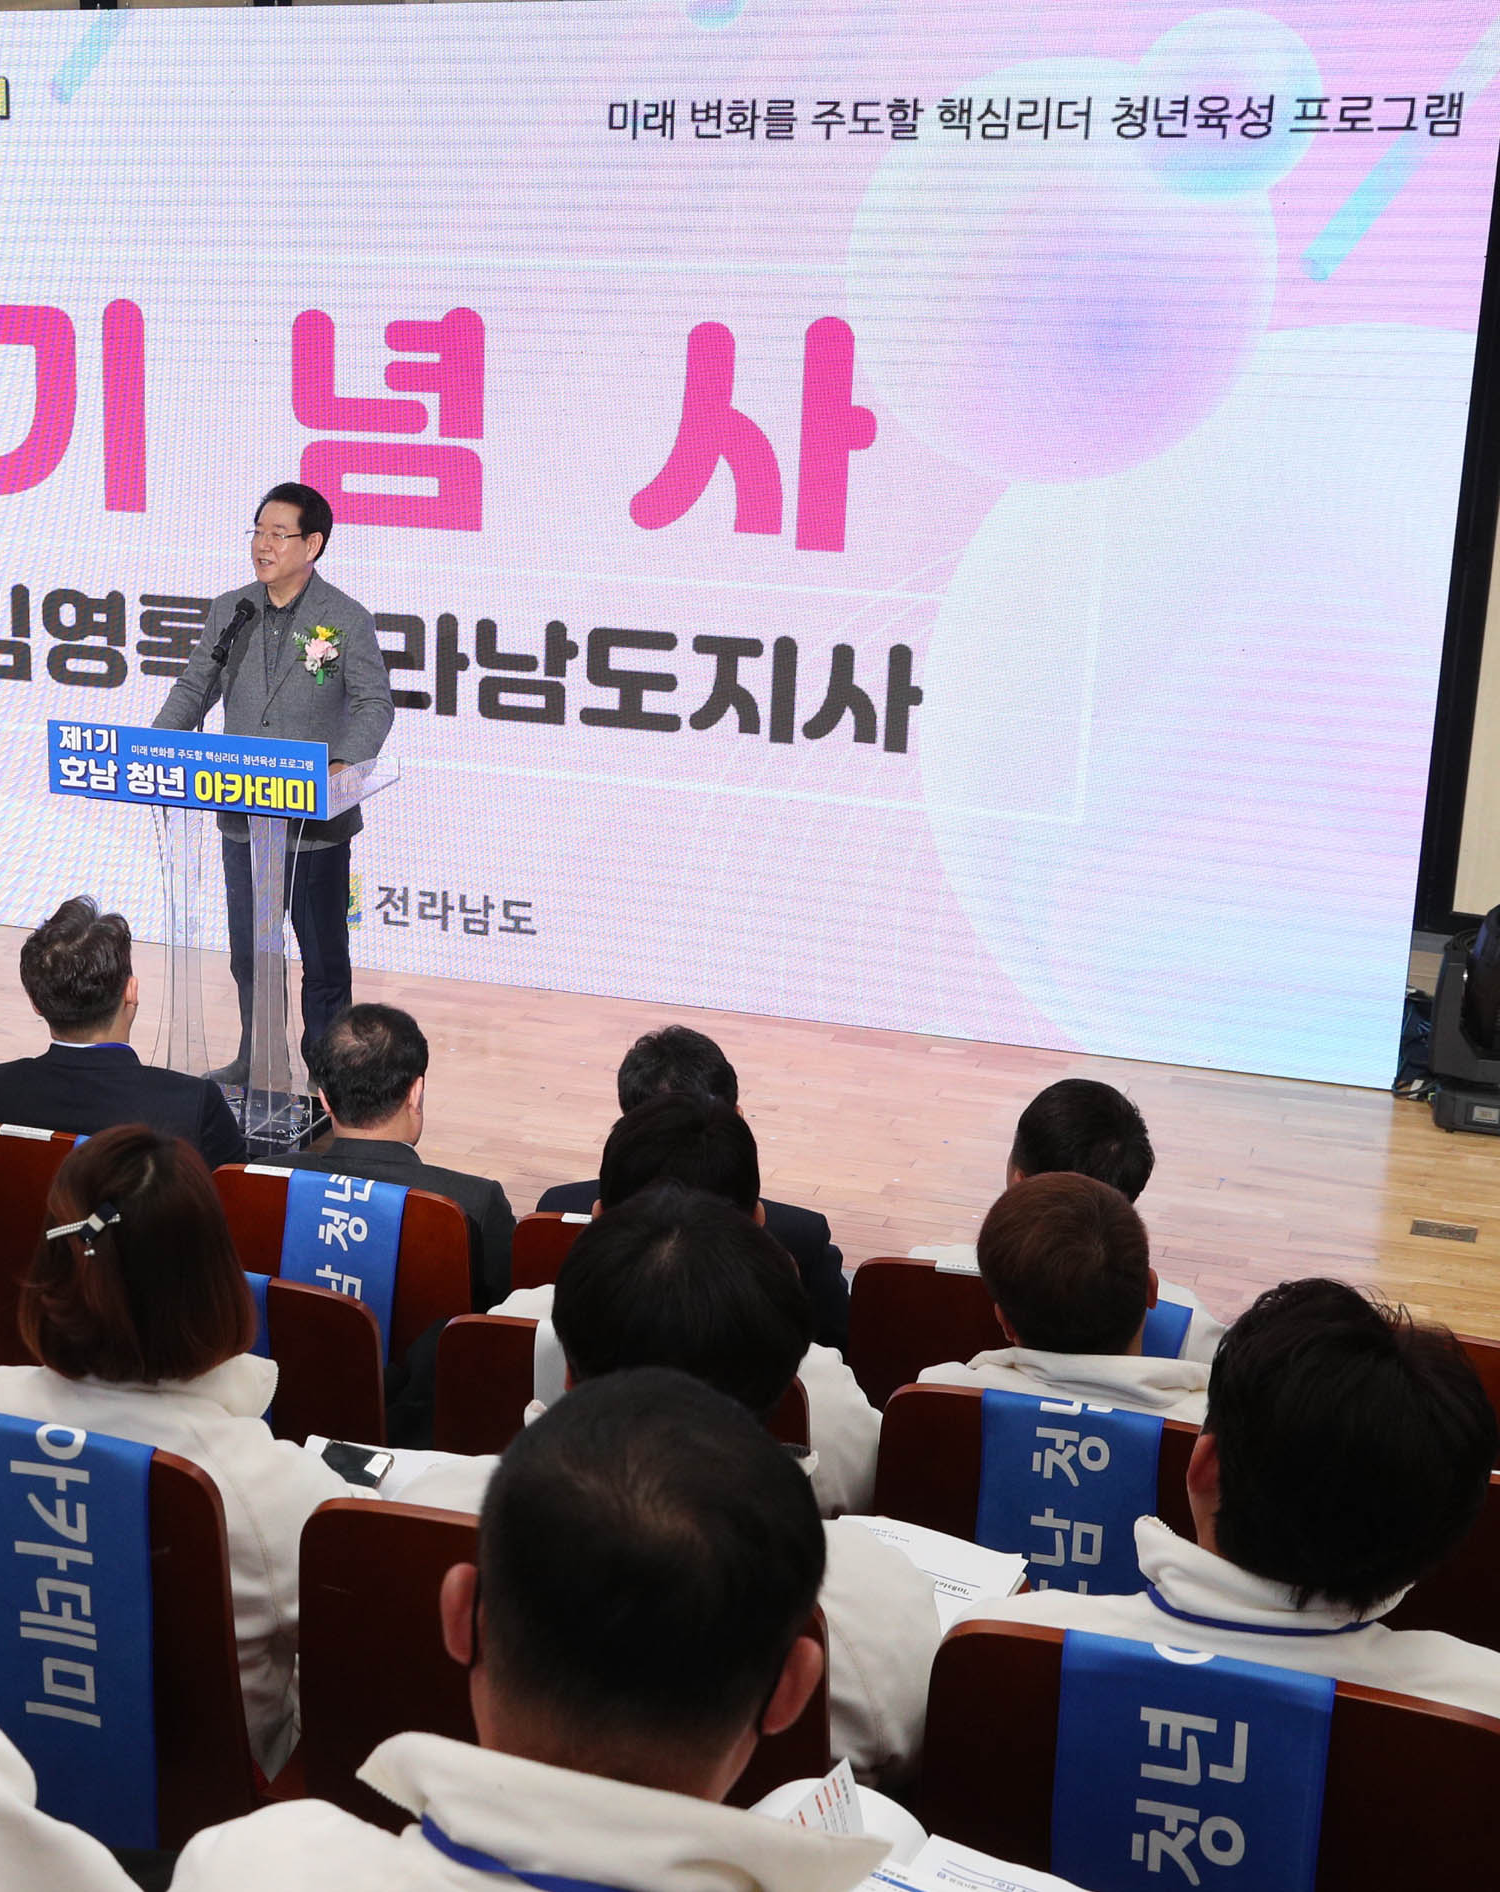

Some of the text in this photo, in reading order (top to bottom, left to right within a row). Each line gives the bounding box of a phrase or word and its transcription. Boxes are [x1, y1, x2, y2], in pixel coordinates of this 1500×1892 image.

[608, 91, 1465, 141] 미래 변화를 주도할 핵심리더 청년육성 프로그램
[372, 612, 923, 754] 라남도지사
[59, 725, 118, 755] 제1기
[131, 744, 315, 771] 미래 변화를 주도할 핵심리더 청년육성 프로그램
[59, 756, 316, 812] 호남 청년 아카데미
[374, 885, 538, 936] 전라남도
[10, 1423, 101, 1728] 아카데미
[1131, 1706, 1248, 1887] 청년
